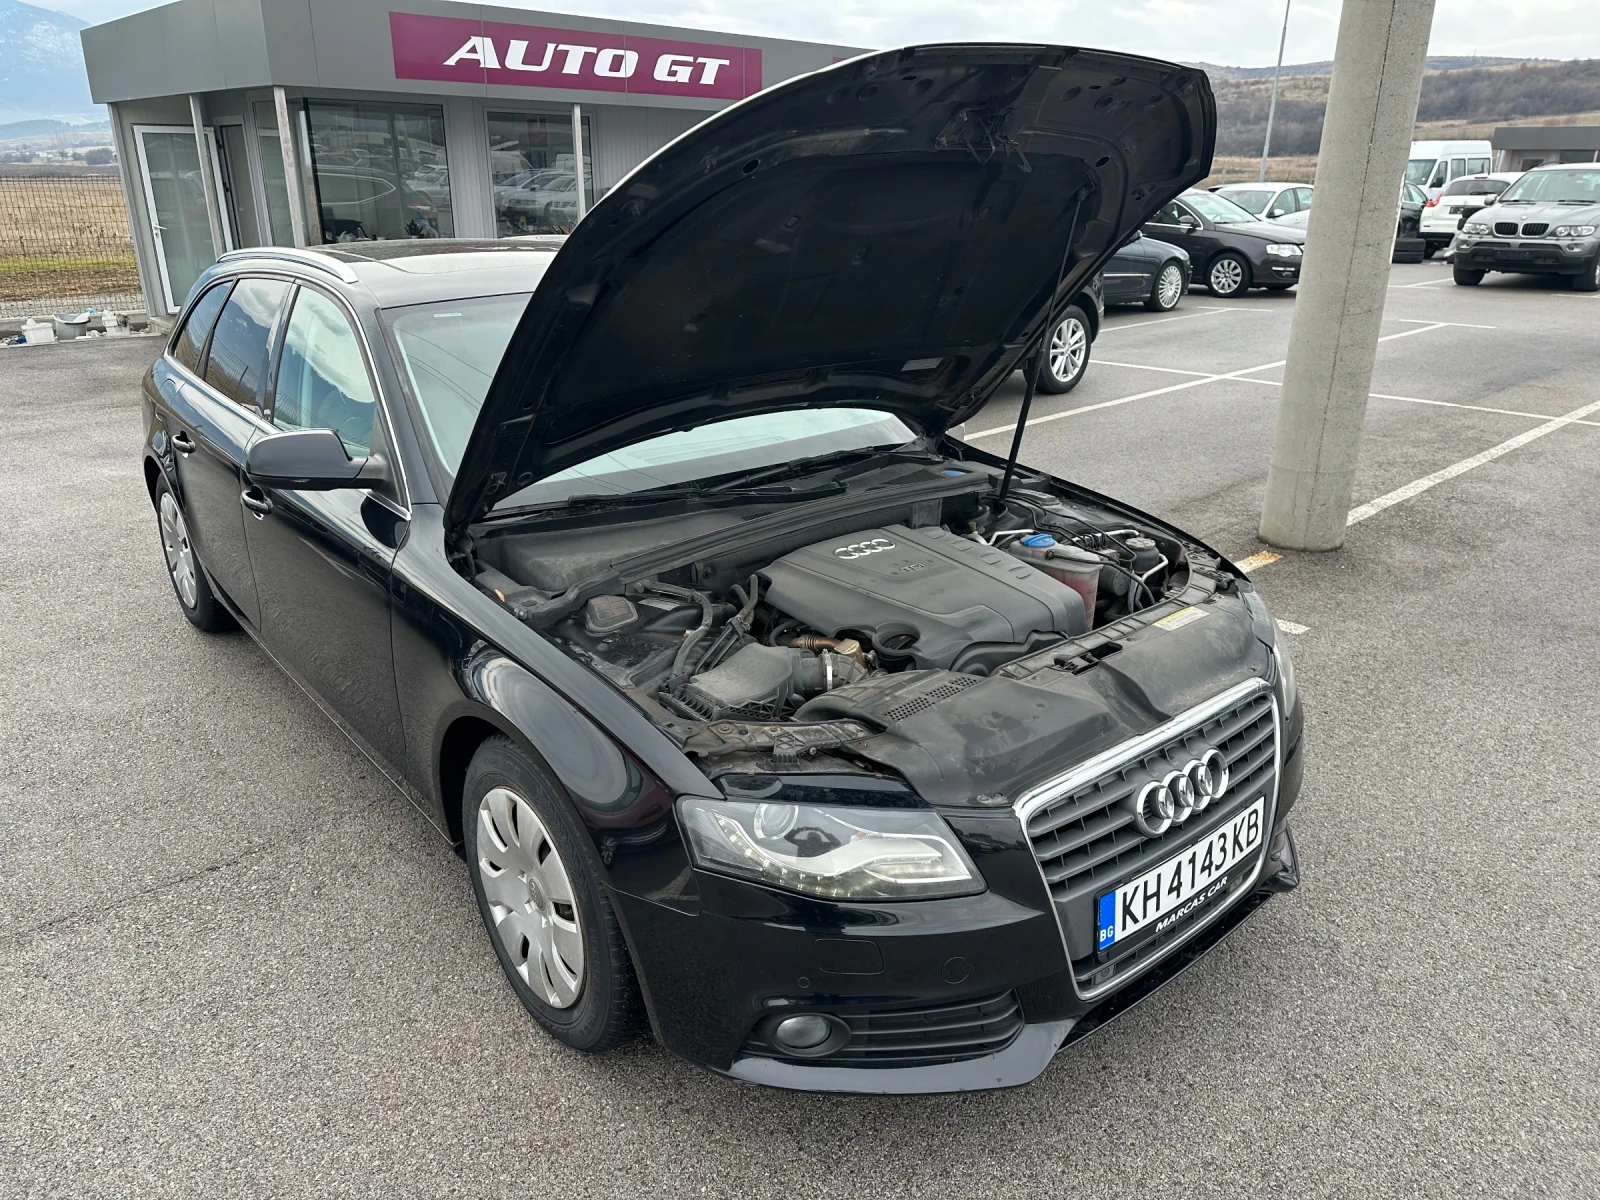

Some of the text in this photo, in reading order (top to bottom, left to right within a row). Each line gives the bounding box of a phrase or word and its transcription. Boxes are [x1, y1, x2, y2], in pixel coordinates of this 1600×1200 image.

[443, 35, 730, 85] AUTO GT
[1155, 876, 1228, 933] MARCAS CAR
[1100, 925, 1114, 943] BG
